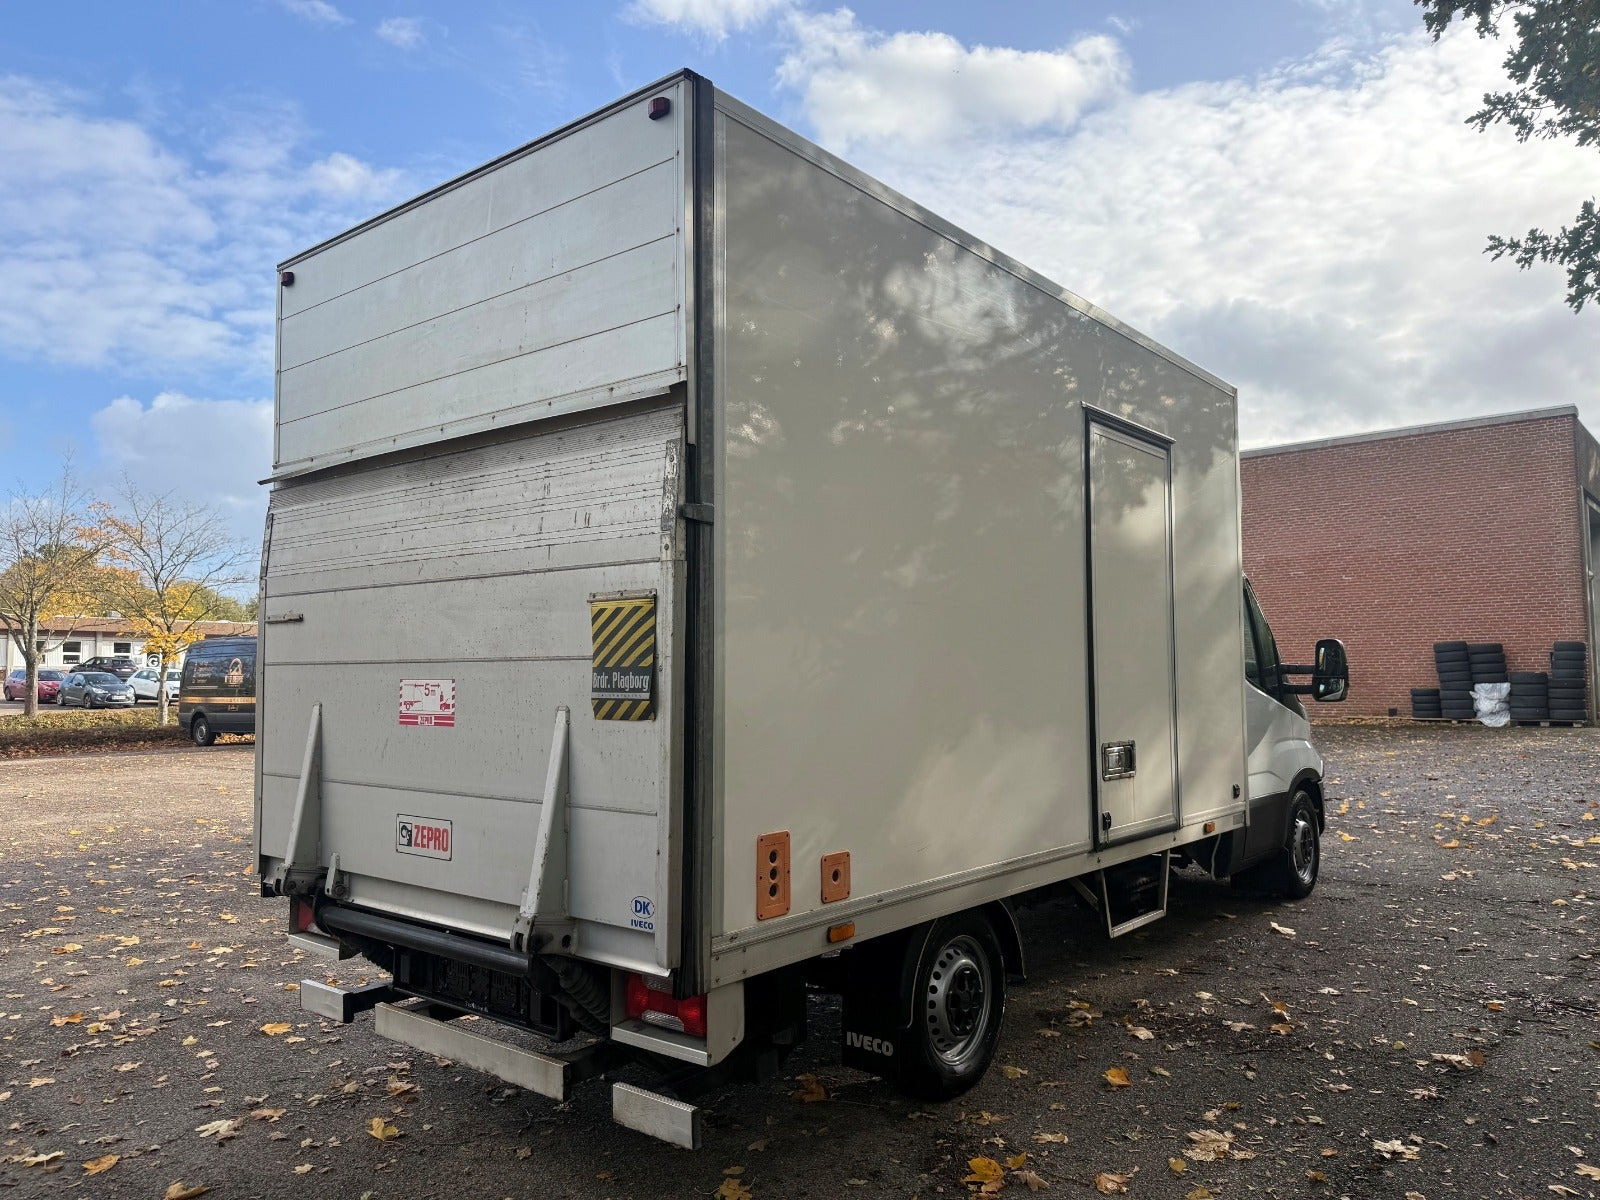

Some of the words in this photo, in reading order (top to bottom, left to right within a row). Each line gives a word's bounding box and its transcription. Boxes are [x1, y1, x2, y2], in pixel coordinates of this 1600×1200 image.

[593, 672, 611, 689] Brdr.
[612, 671, 650, 692] Plagborg
[413, 824, 449, 852] ZEPRO
[634, 899, 651, 916] DK
[630, 918, 654, 930] IVECO
[846, 1031, 894, 1057] IVECO
